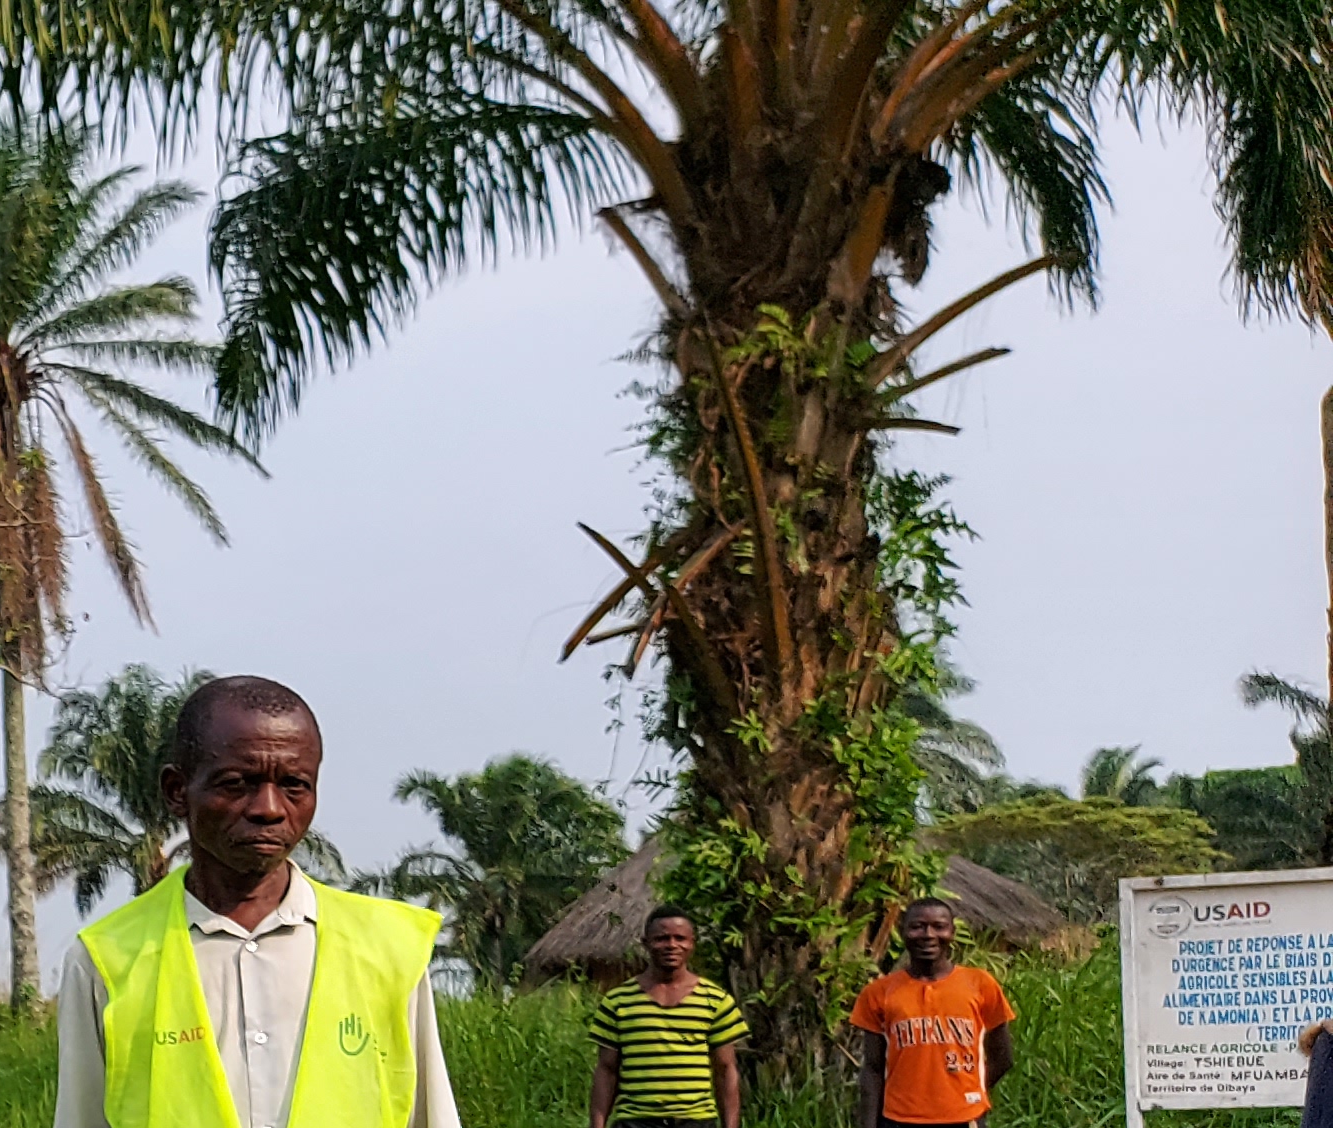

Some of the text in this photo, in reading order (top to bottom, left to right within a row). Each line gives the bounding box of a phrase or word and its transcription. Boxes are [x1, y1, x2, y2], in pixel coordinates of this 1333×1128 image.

[1194, 901, 1271, 922] USAID
[1179, 939, 1224, 956] PROJET
[1228, 938, 1243, 954] DE
[1247, 934, 1304, 953] REPONSE
[1307, 934, 1316, 949] A
[1239, 954, 1262, 971] PAR
[1266, 953, 1281, 969] LE
[1285, 951, 1317, 969] BIAIS
[1178, 973, 1239, 990] AGRICOLE
[1243, 970, 1307, 988] SENSIBLES
[1309, 969, 1318, 985] A
[1162, 991, 1241, 1009] ALIMENTAIRE
[1244, 989, 1277, 1006] DANS
[1281, 988, 1297, 1005] LA
[1178, 1010, 1195, 1026] DE
[1273, 1007, 1289, 1023] ET
[1294, 1005, 1311, 1022] LA
[155, 1026, 206, 1046] USAID
[891, 1016, 974, 1050] TITANS
[1147, 1043, 1207, 1055] RELANCE
[1211, 1043, 1279, 1055] AGRICOLE
[1147, 1071, 1169, 1081] Aire
[1172, 1071, 1186, 1081] de
[1147, 1083, 1256, 1095] Territoire de Dibaya
